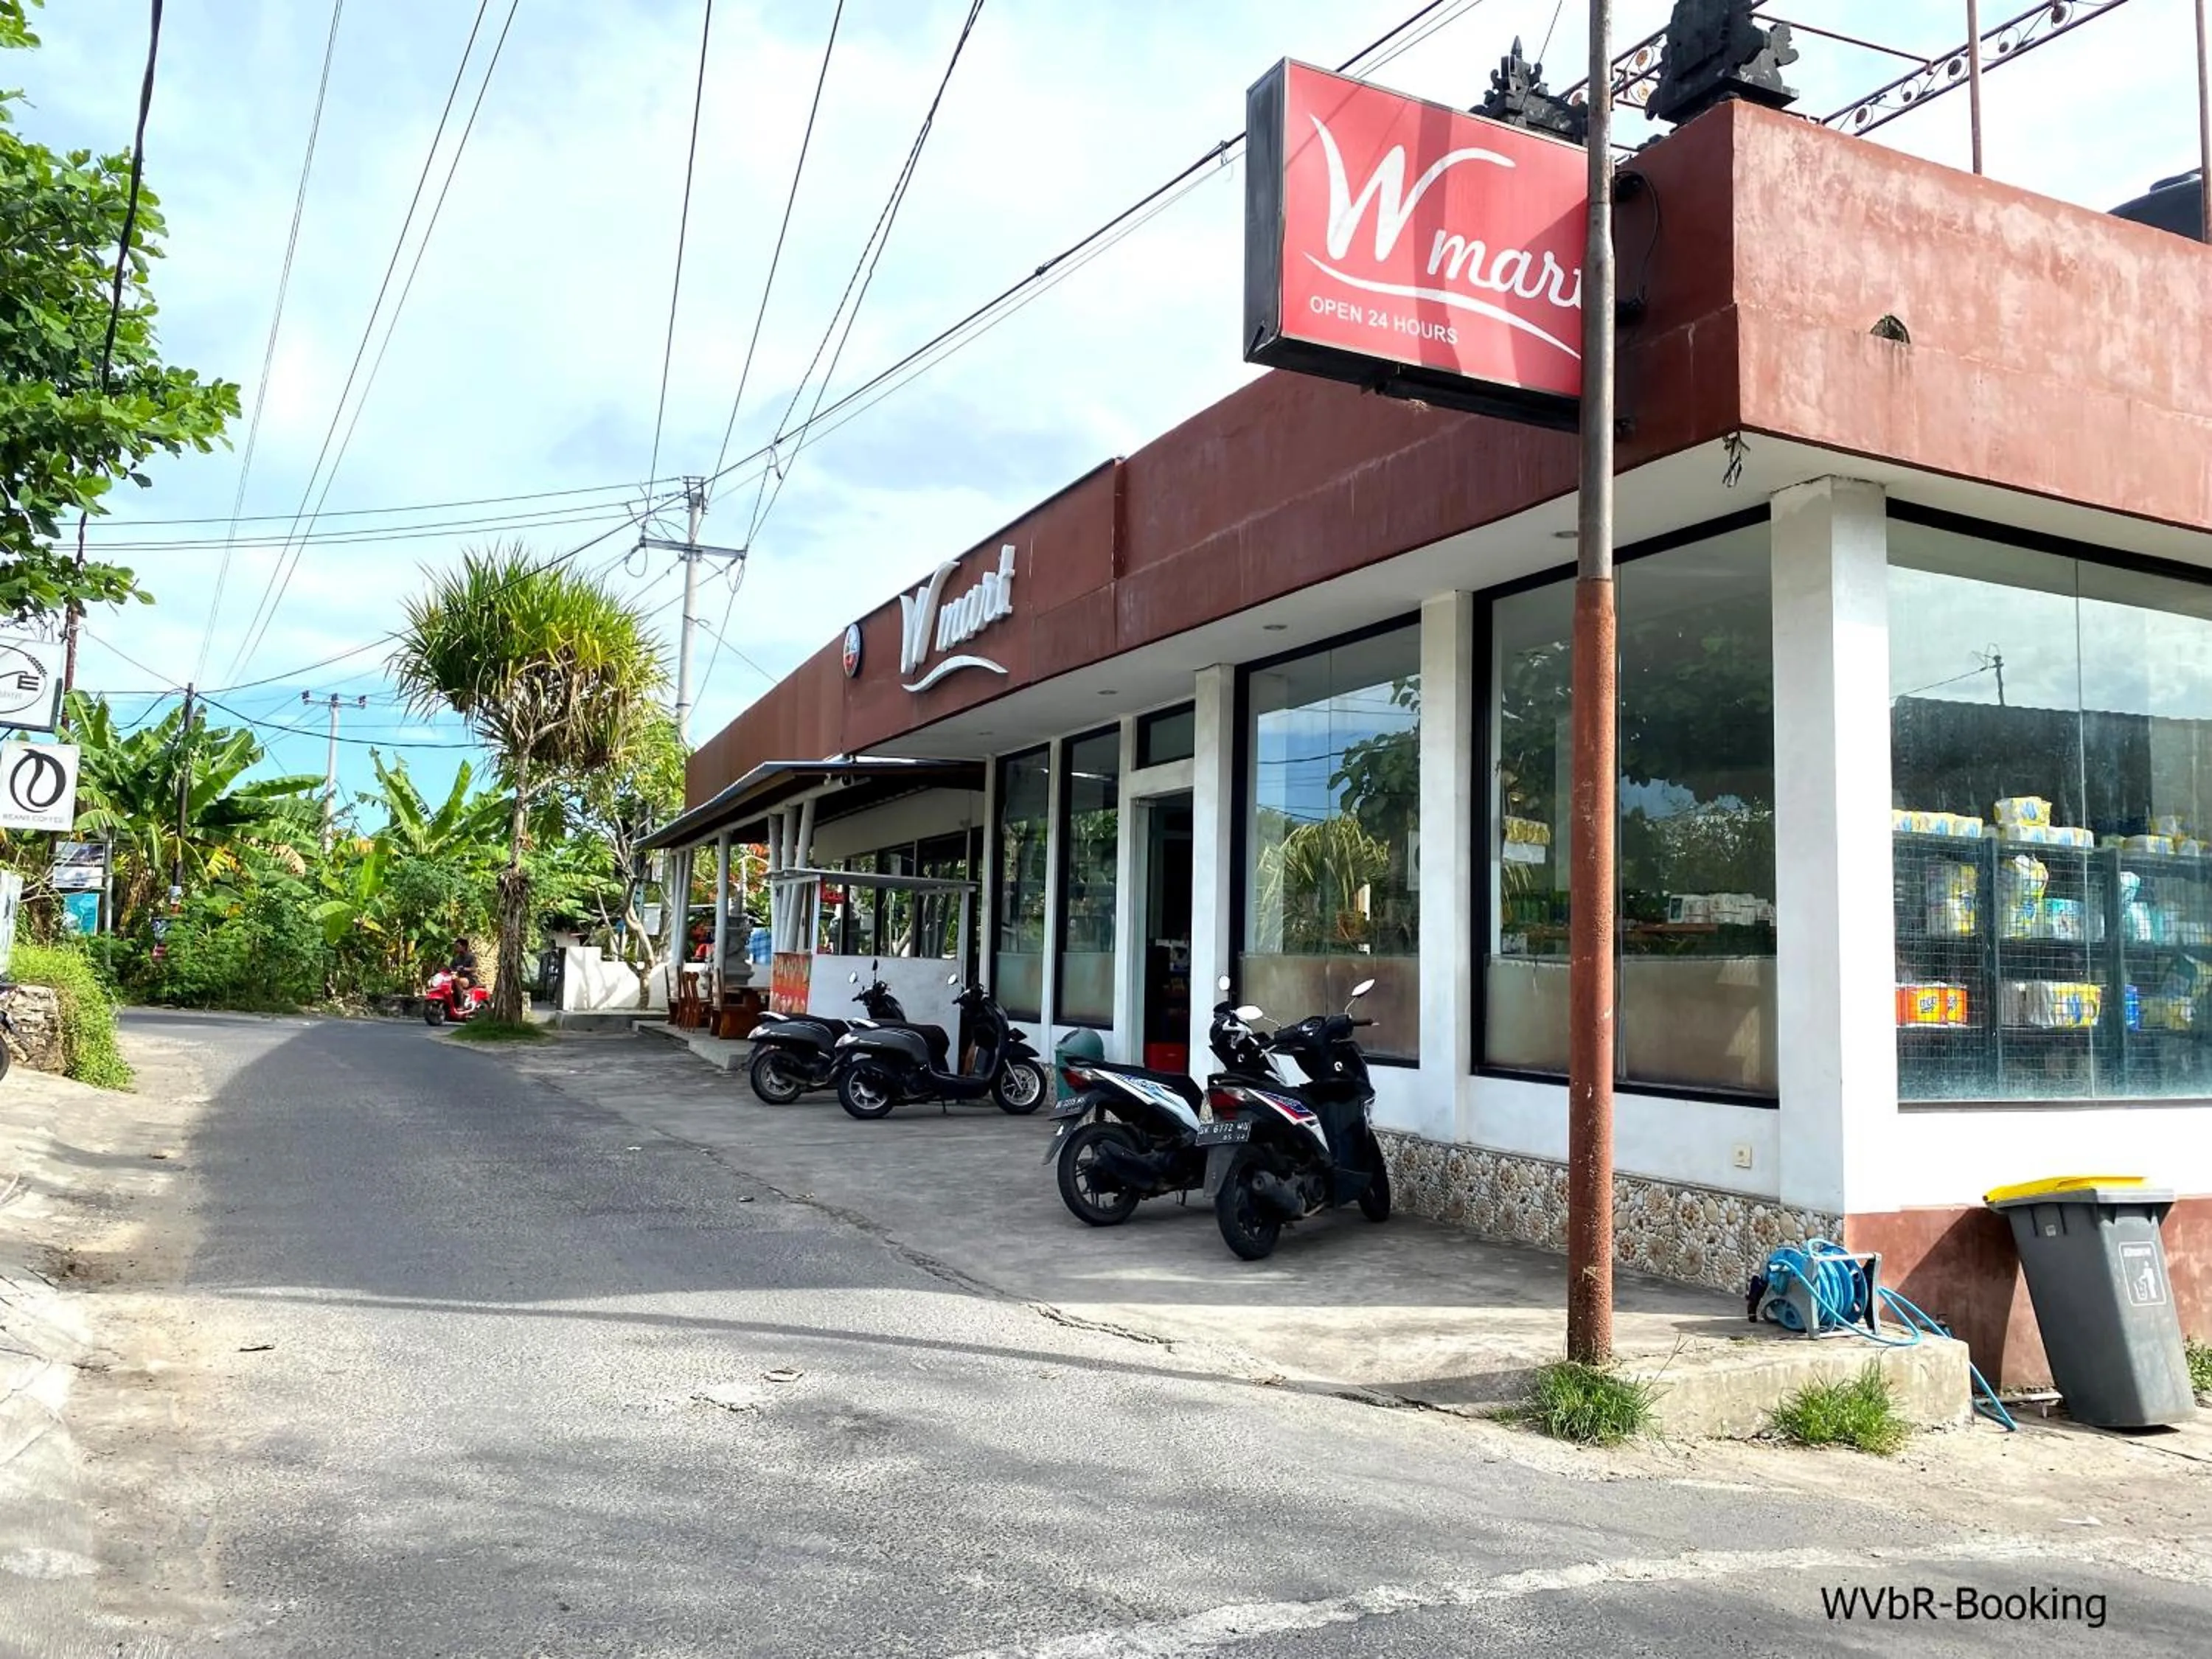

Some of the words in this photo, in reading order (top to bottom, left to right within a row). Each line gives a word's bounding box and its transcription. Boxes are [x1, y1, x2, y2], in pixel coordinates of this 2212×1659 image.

[1308, 113, 1517, 262] W
[1310, 295, 1363, 324] OPEN
[1368, 309, 1389, 329] 24
[1393, 315, 1459, 344] HOURS
[935, 543, 1016, 653] mart
